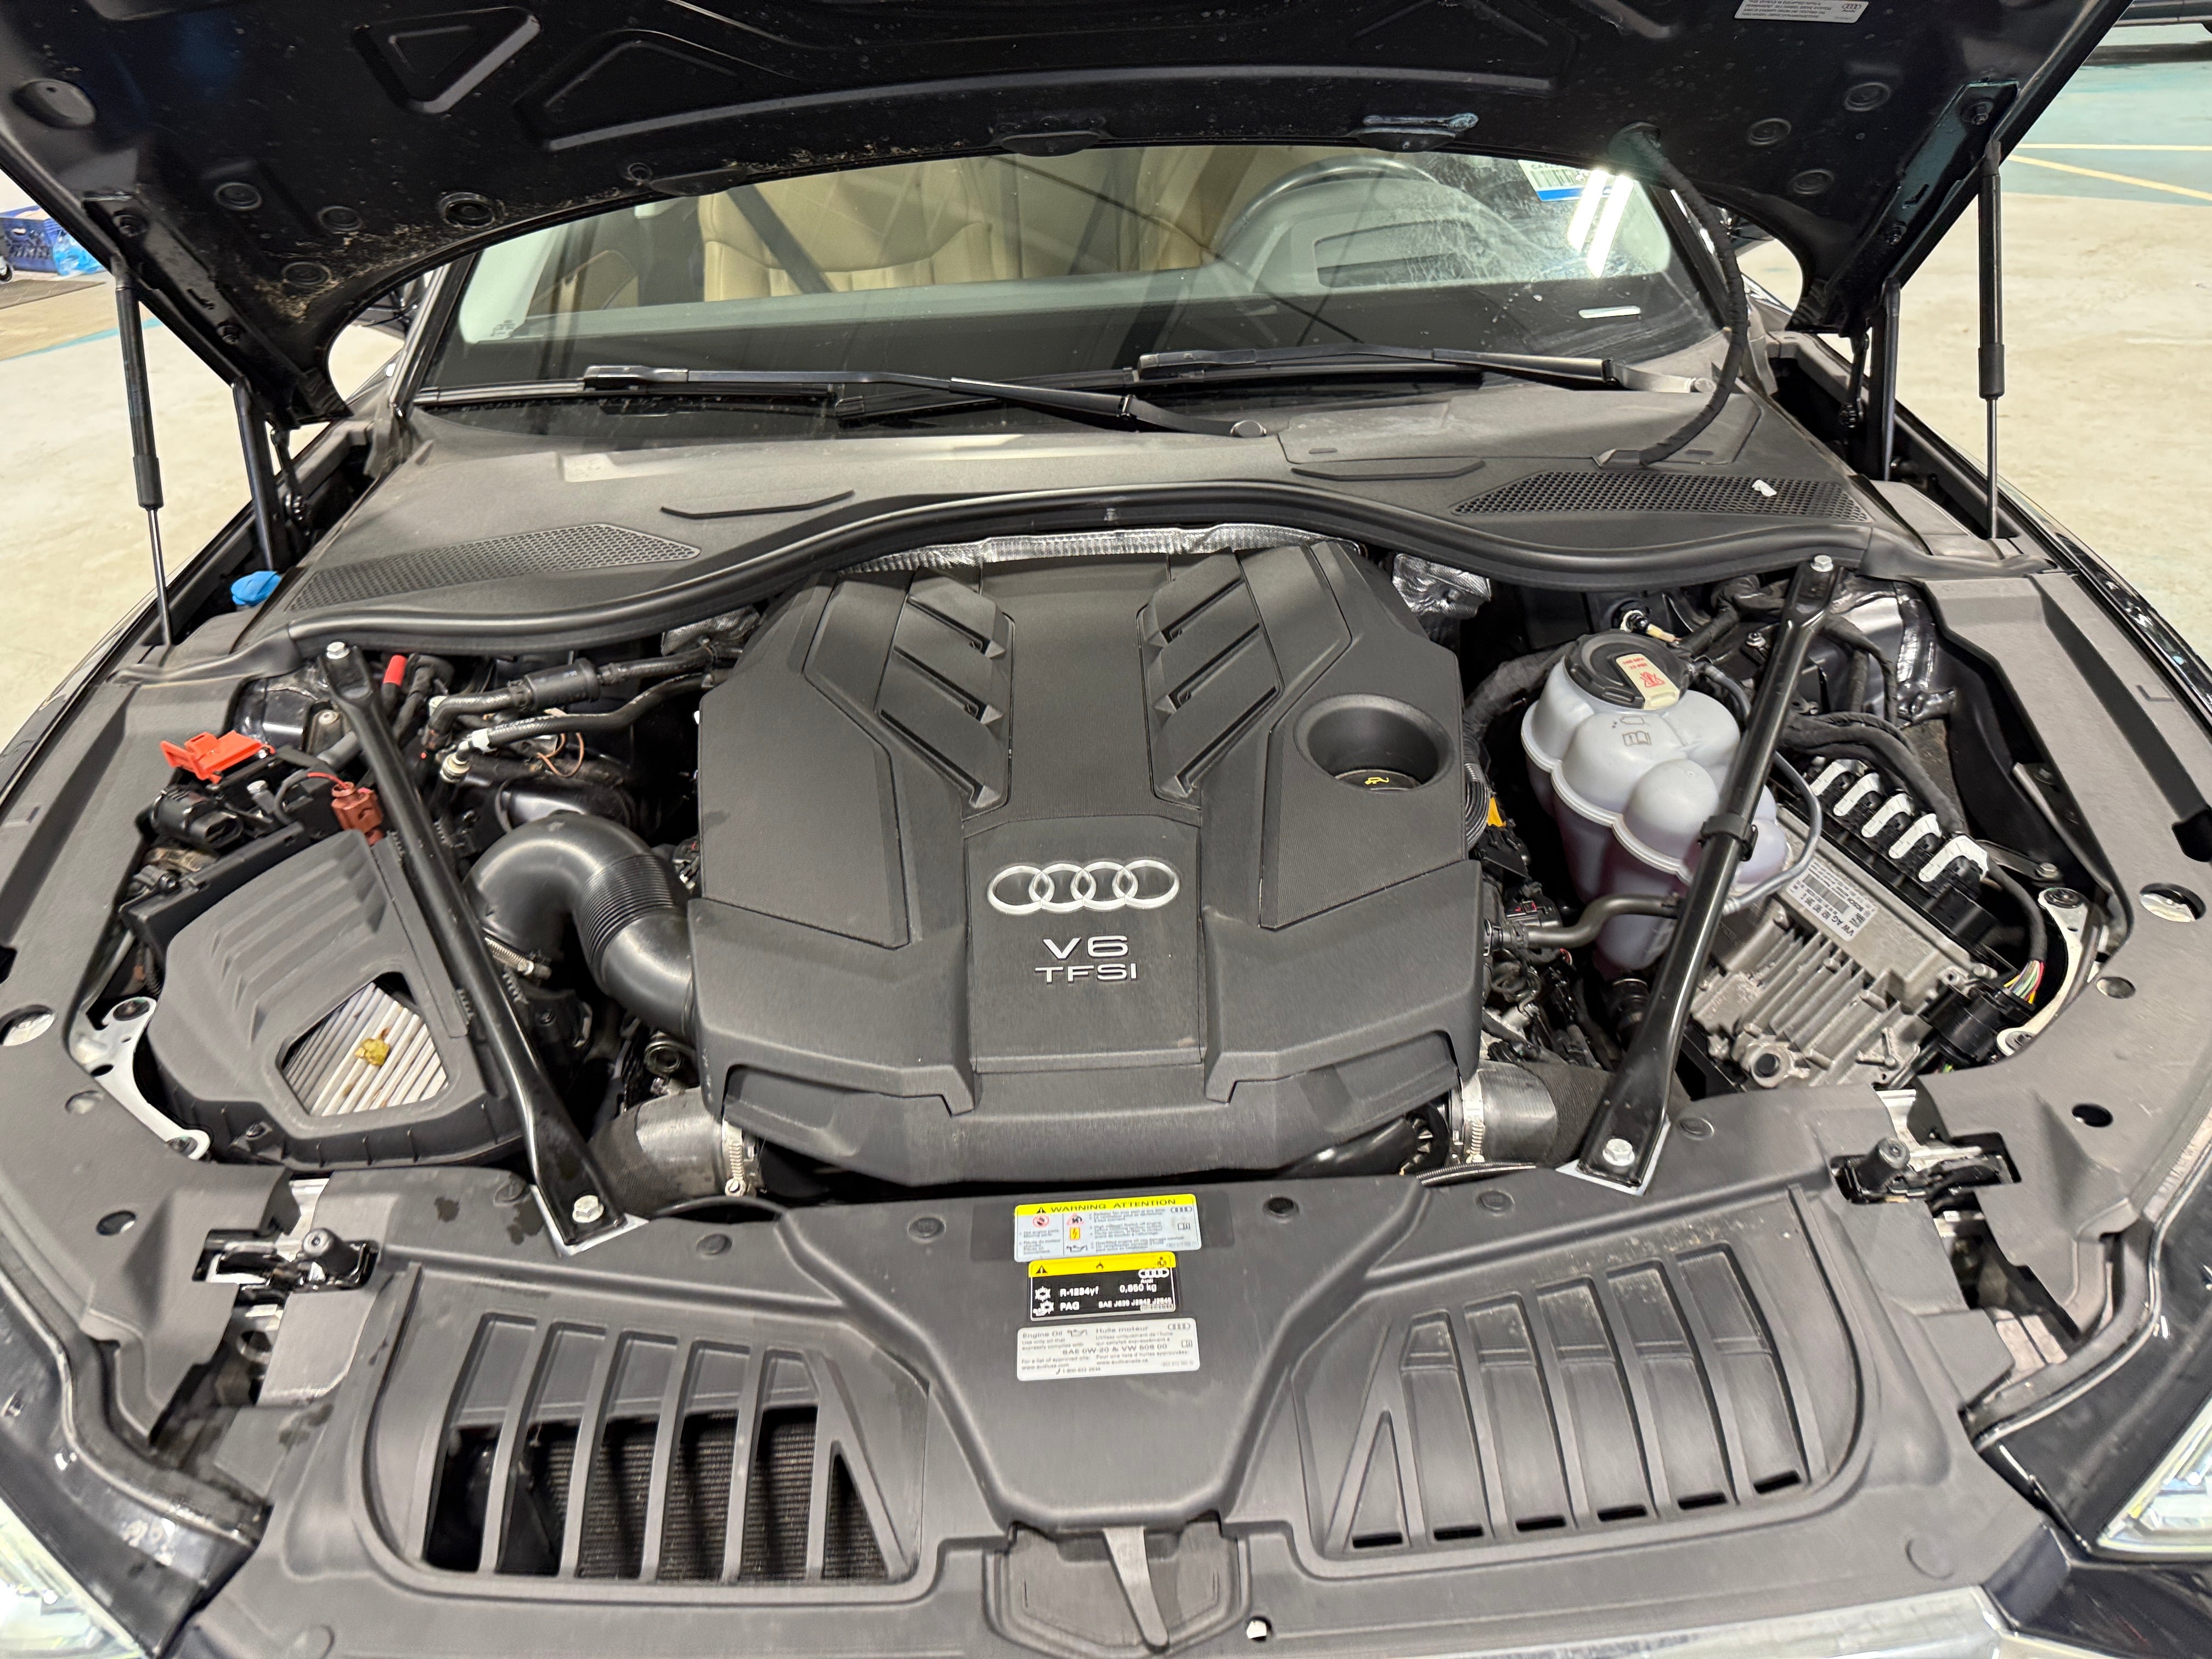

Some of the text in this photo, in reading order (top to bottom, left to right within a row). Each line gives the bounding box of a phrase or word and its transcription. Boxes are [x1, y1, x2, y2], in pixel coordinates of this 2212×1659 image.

[1831, 915, 1843, 926] AG
[1841, 923, 1855, 936] VW
[1043, 935, 1128, 960] V6
[1035, 963, 1137, 983] TFSI
[1051, 1199, 1176, 1213] WARNING ATTENTION
[1146, 1283, 1157, 1293] kg
[1060, 1301, 1080, 1311] PAG
